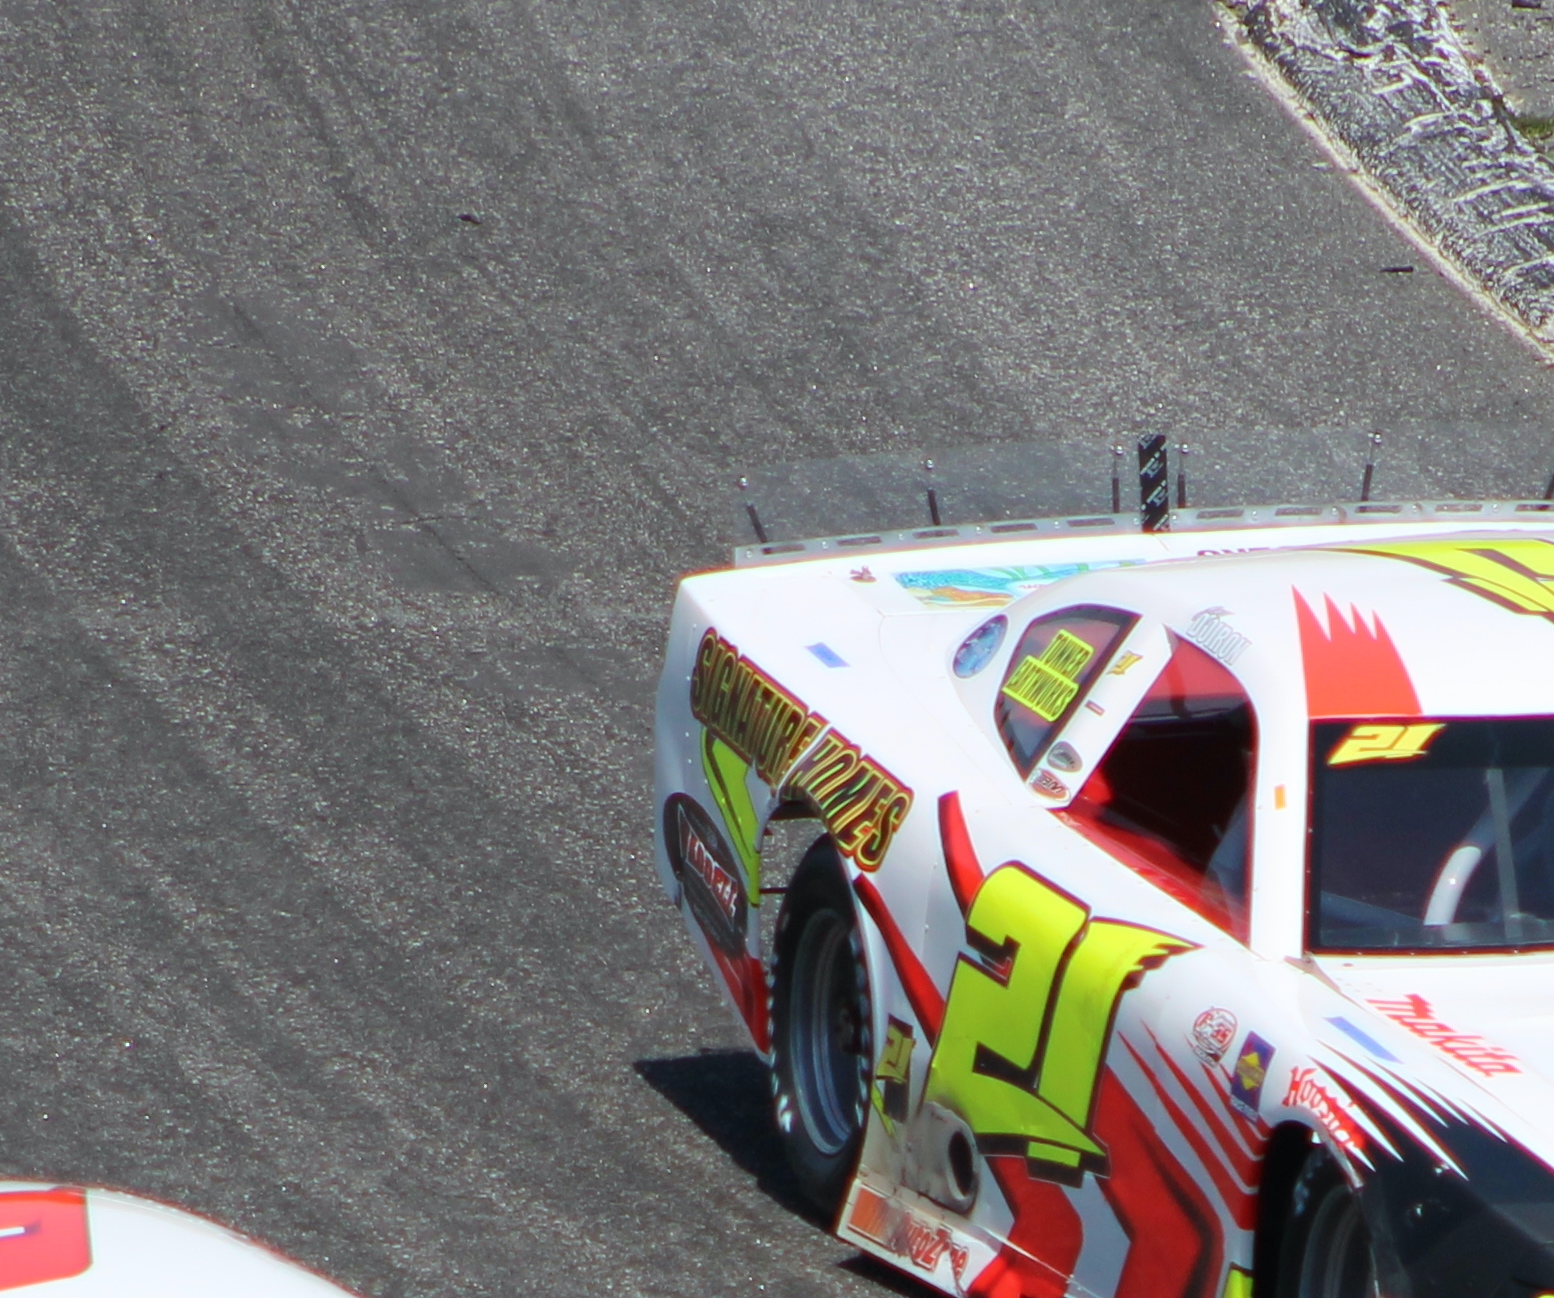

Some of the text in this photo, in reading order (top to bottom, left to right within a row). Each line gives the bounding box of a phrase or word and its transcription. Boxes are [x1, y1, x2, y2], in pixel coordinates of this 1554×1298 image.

[690, 627, 831, 796] SIGNATURE
[778, 727, 914, 872] HOMES
[1328, 722, 1445, 766] 21
[923, 859, 1205, 1172] 21
